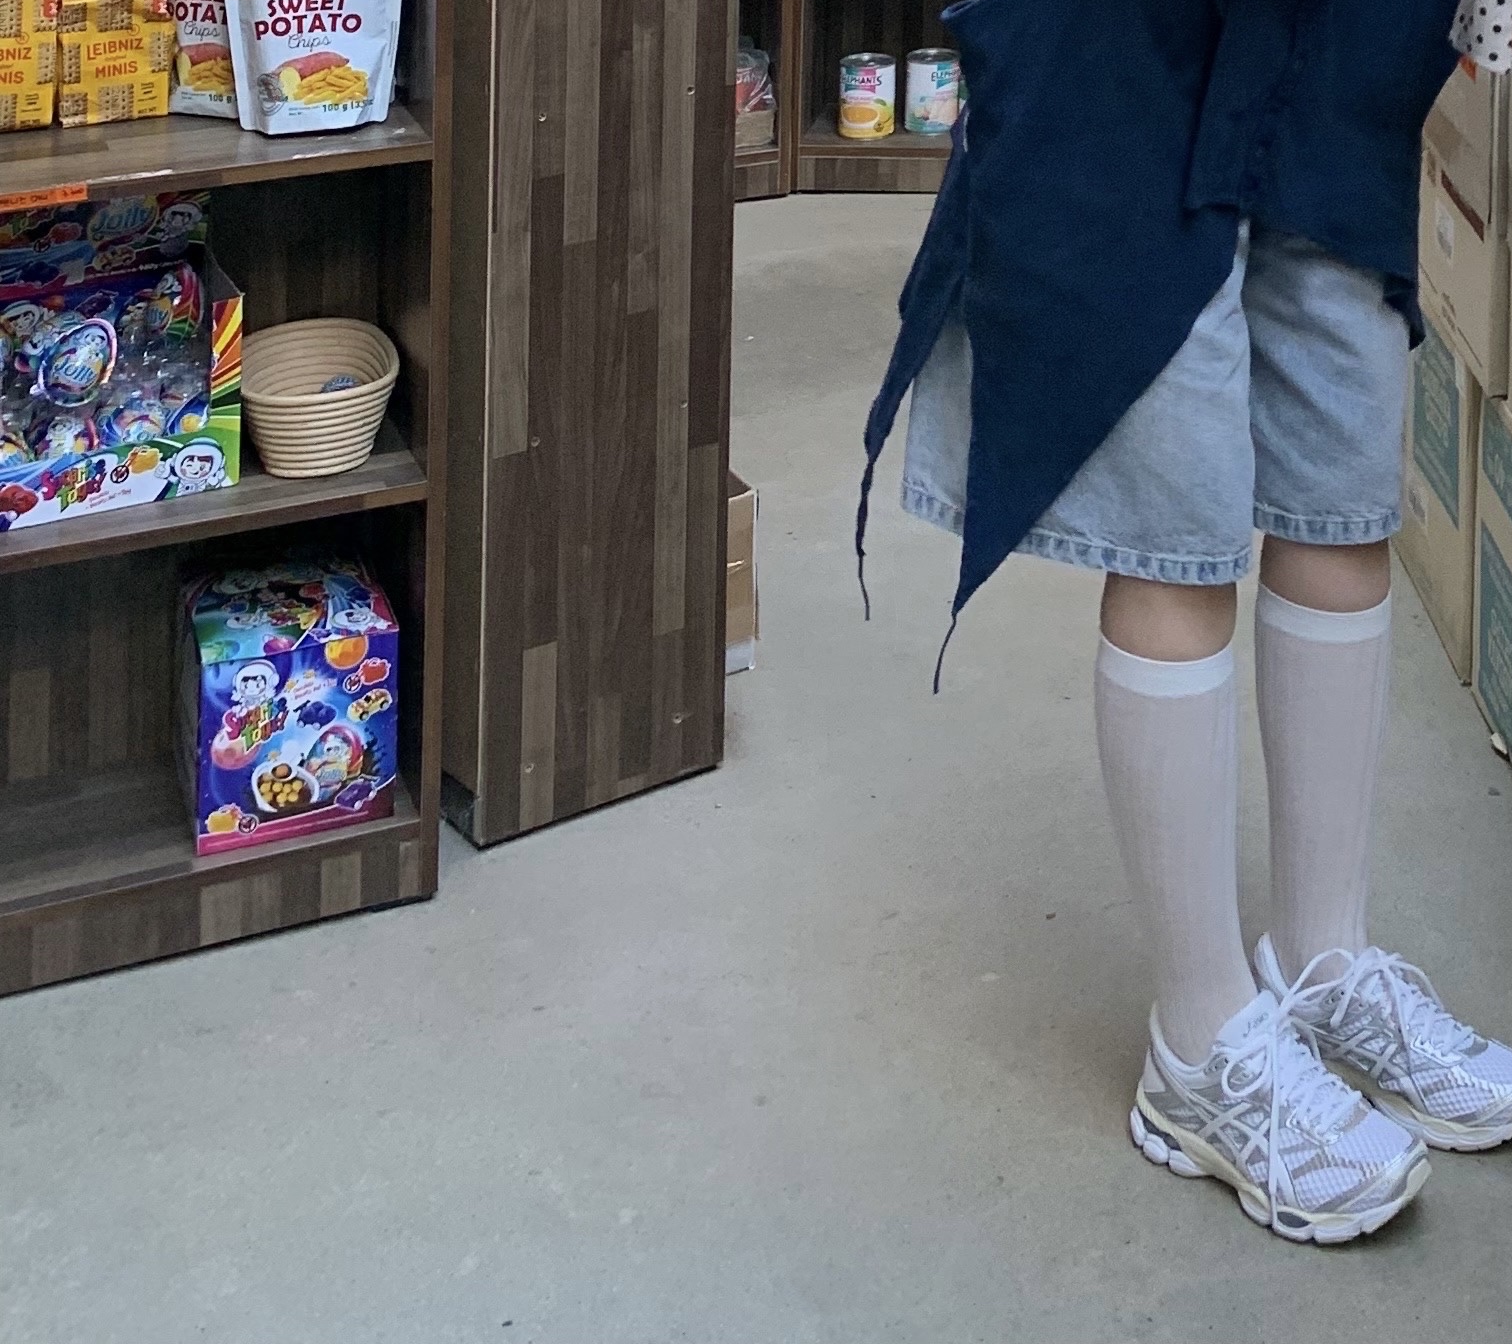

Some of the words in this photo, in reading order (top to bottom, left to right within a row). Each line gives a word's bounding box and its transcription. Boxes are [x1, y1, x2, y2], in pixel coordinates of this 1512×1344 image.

[254, 12, 363, 42] POTATO
[86, 37, 145, 62] LEIBNIZ
[287, 33, 333, 54] Chips
[94, 60, 139, 80] MINIS
[322, 103, 339, 114] 100
